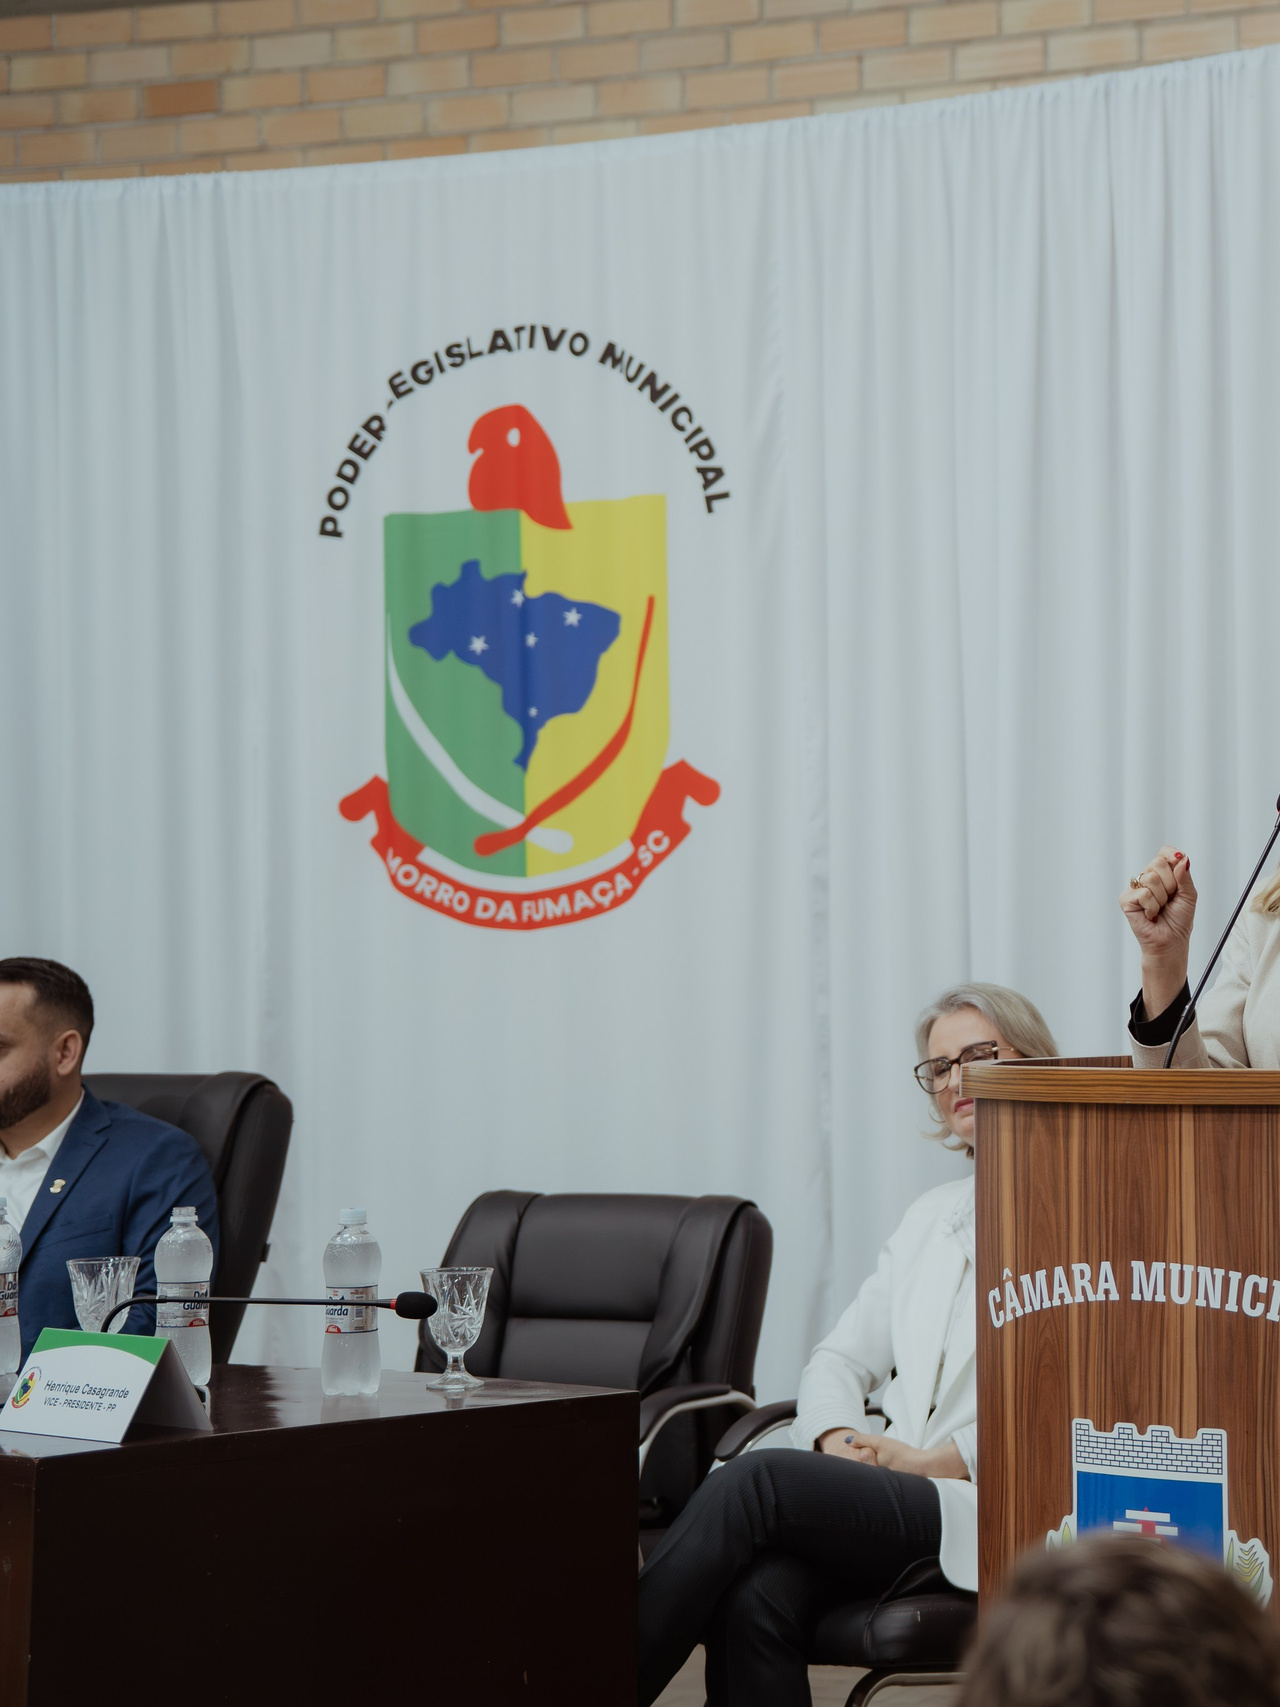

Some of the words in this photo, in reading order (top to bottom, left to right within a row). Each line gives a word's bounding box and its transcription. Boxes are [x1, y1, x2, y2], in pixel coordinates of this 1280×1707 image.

[318, 414, 386, 538] PODER
[387, 325, 590, 410] EGISLATIVO
[599, 341, 730, 514] MUNICIPAL
[474, 896, 517, 922] DA
[522, 872, 633, 923] FUMAÇA
[639, 829, 670, 867] SC
[988, 1261, 1120, 1328] CÂMARA
[43, 1397, 60, 1406] VICE
[63, 1399, 104, 1411] PRESIDENTE
[106, 1403, 117, 1412] PP
[44, 1380, 81, 1395] Henrique
[81, 1384, 130, 1399] Casagrande
